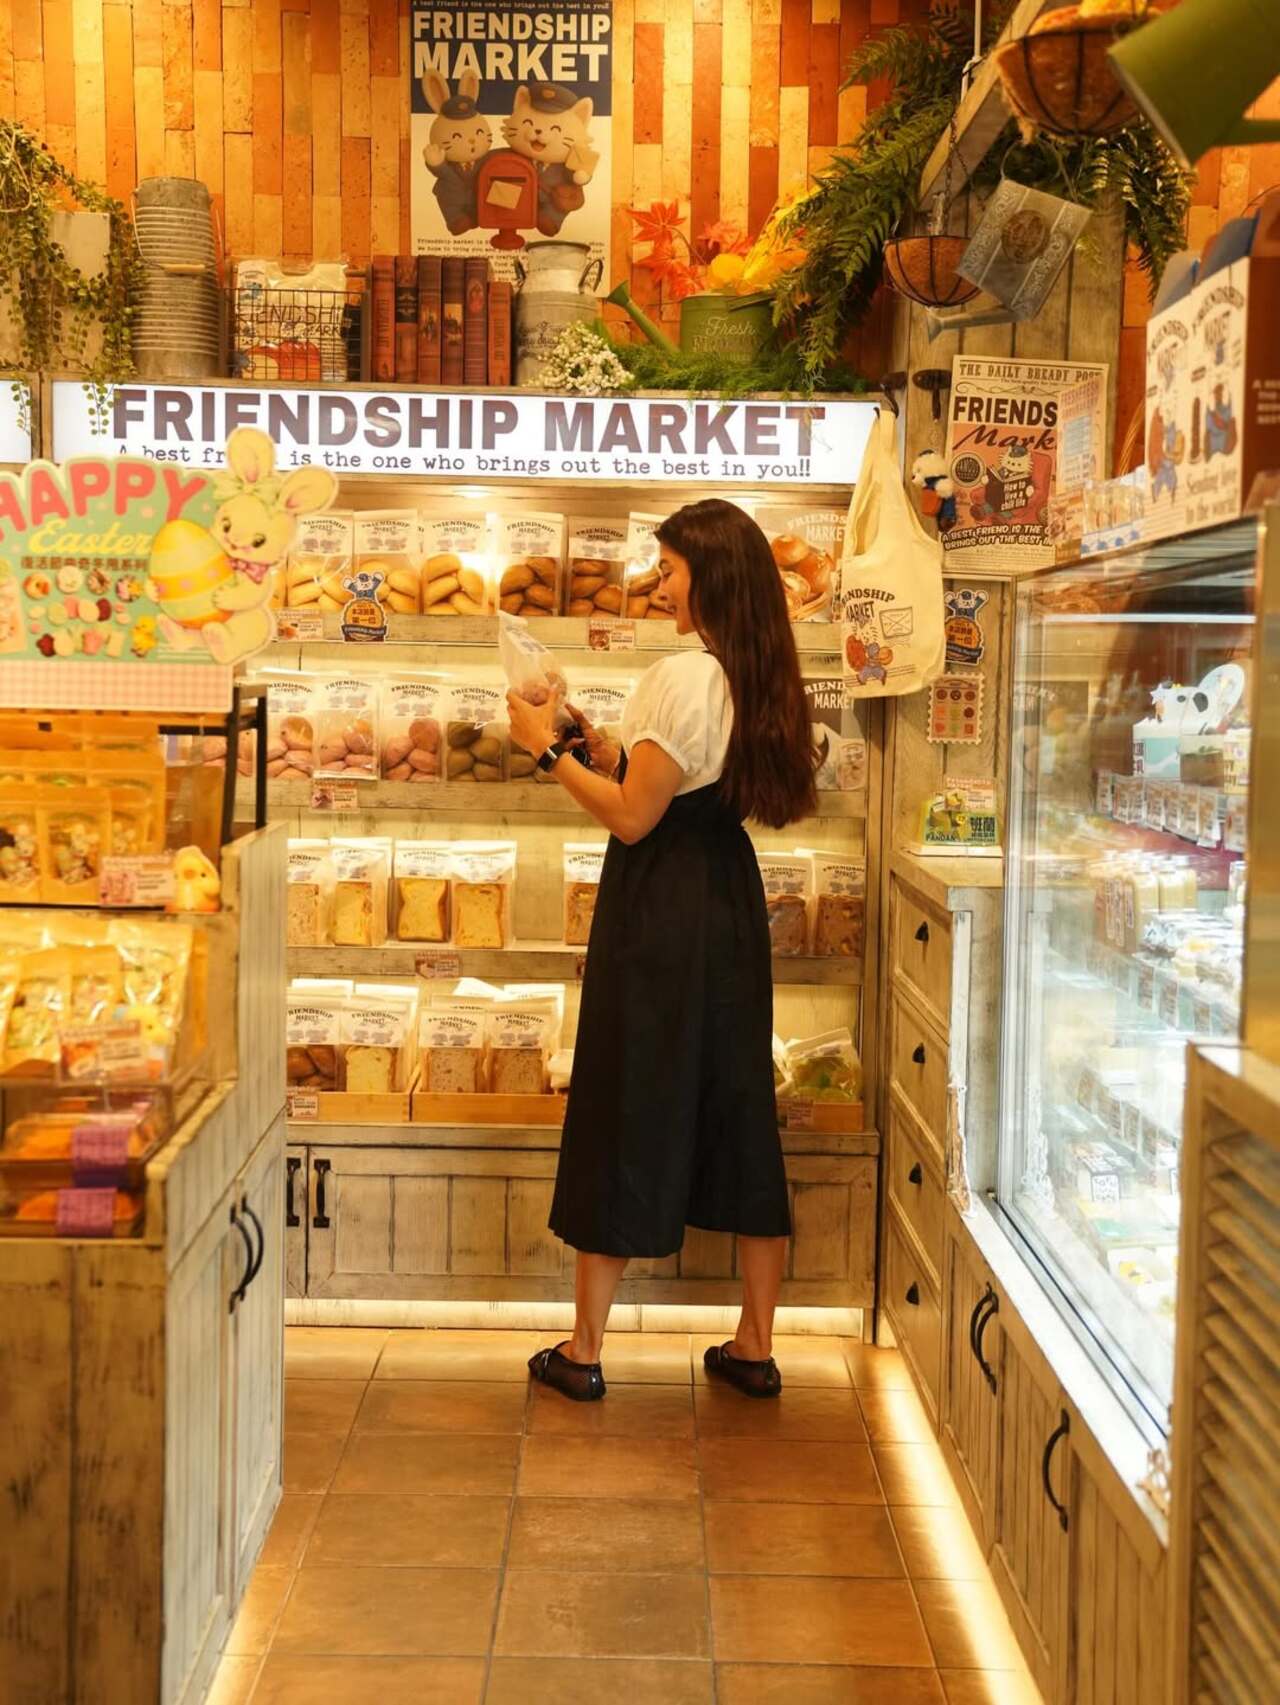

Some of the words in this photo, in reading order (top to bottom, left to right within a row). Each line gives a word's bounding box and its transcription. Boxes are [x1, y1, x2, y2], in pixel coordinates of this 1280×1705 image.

[413, 11, 611, 42] FRIENDSHIP
[414, 41, 609, 82] MARKET
[705, 316, 757, 336] Fresh
[959, 364, 981, 376] THE
[988, 365, 1021, 379] DAILY
[952, 396, 1058, 428] FRIENDS
[113, 388, 519, 451] FRIENDSHIP
[544, 401, 826, 457] MARKET
[952, 424, 1056, 451] Mark
[143, 444, 191, 464] best
[290, 449, 312, 467] is
[323, 449, 361, 468] the
[372, 454, 411, 470] one
[423, 453, 465, 471] who
[477, 455, 551, 475] brings
[561, 459, 601, 474] out
[612, 458, 650, 475] the
[663, 459, 710, 476] best
[721, 460, 746, 477] in
[757, 459, 811, 480] you!!
[506, 520, 556, 534] FRIENDSHIP
[787, 513, 848, 530] FRIENDS
[27, 517, 153, 555] Easter
[806, 526, 846, 542] MARKE
[976, 525, 1009, 536] FRIEND
[1024, 525, 1043, 534] THE
[979, 535, 996, 545] OUT
[999, 535, 1017, 544] THE
[1018, 535, 1041, 545] BEST
[450, 687, 500, 699] FRIENDSHIP
[577, 687, 626, 700] FRIENDSHIP
[803, 681, 848, 695] RIEND
[813, 693, 851, 710] MARKE
[287, 1007, 335, 1019] RIENDSHIP
